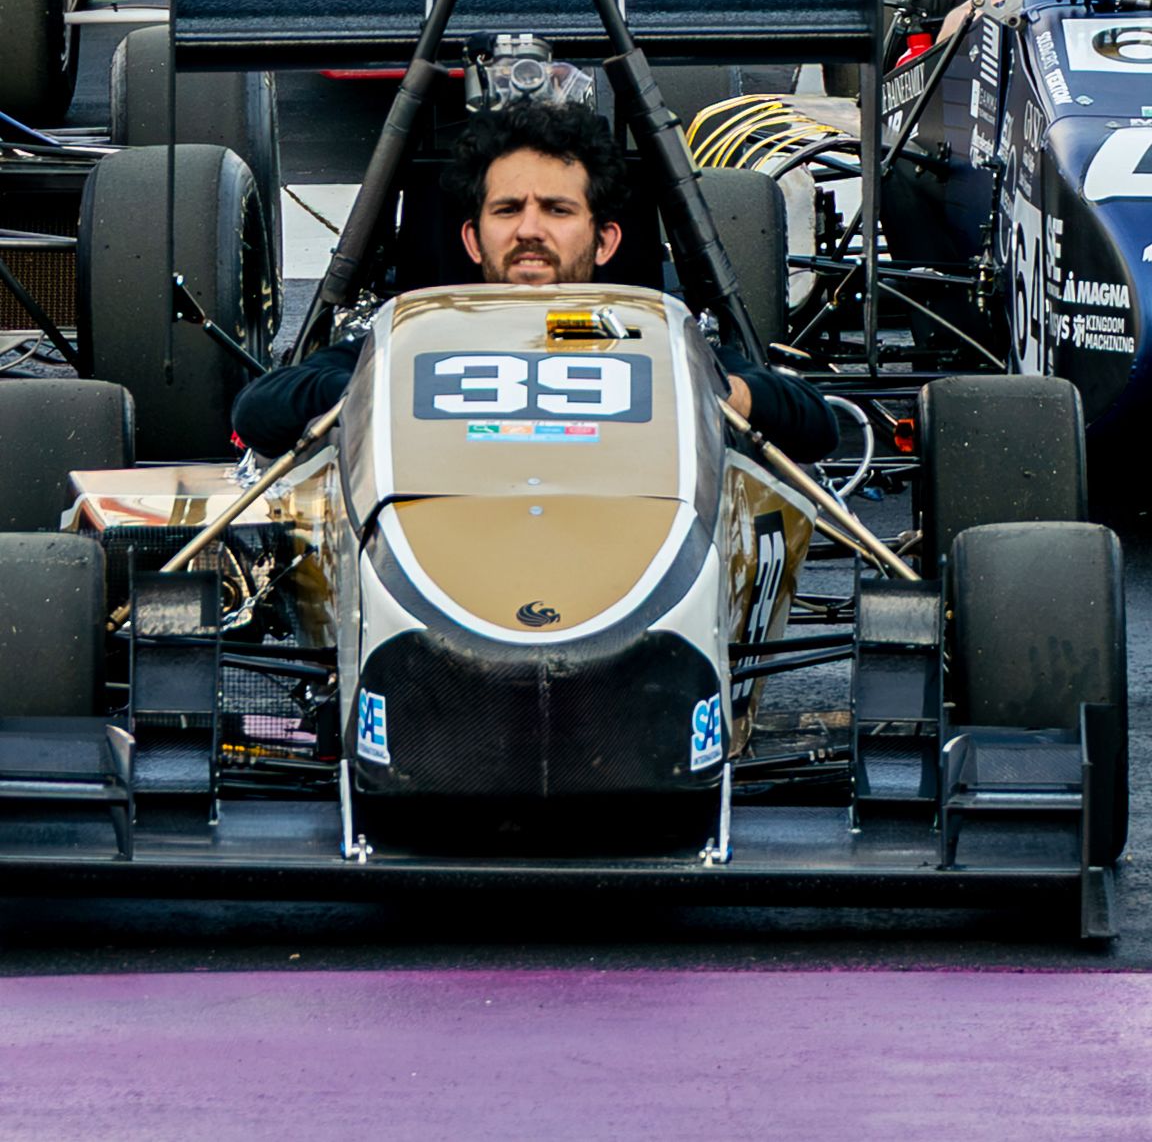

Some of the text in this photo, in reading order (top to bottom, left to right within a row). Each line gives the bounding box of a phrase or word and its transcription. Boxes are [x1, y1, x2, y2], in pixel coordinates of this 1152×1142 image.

[1077, 280, 1131, 309] MAGNA
[1084, 333, 1134, 354] MACHINING
[1085, 314, 1125, 335] KINGDOM
[433, 355, 631, 415] 39
[360, 690, 385, 746] SAE
[695, 698, 721, 751] SAE
